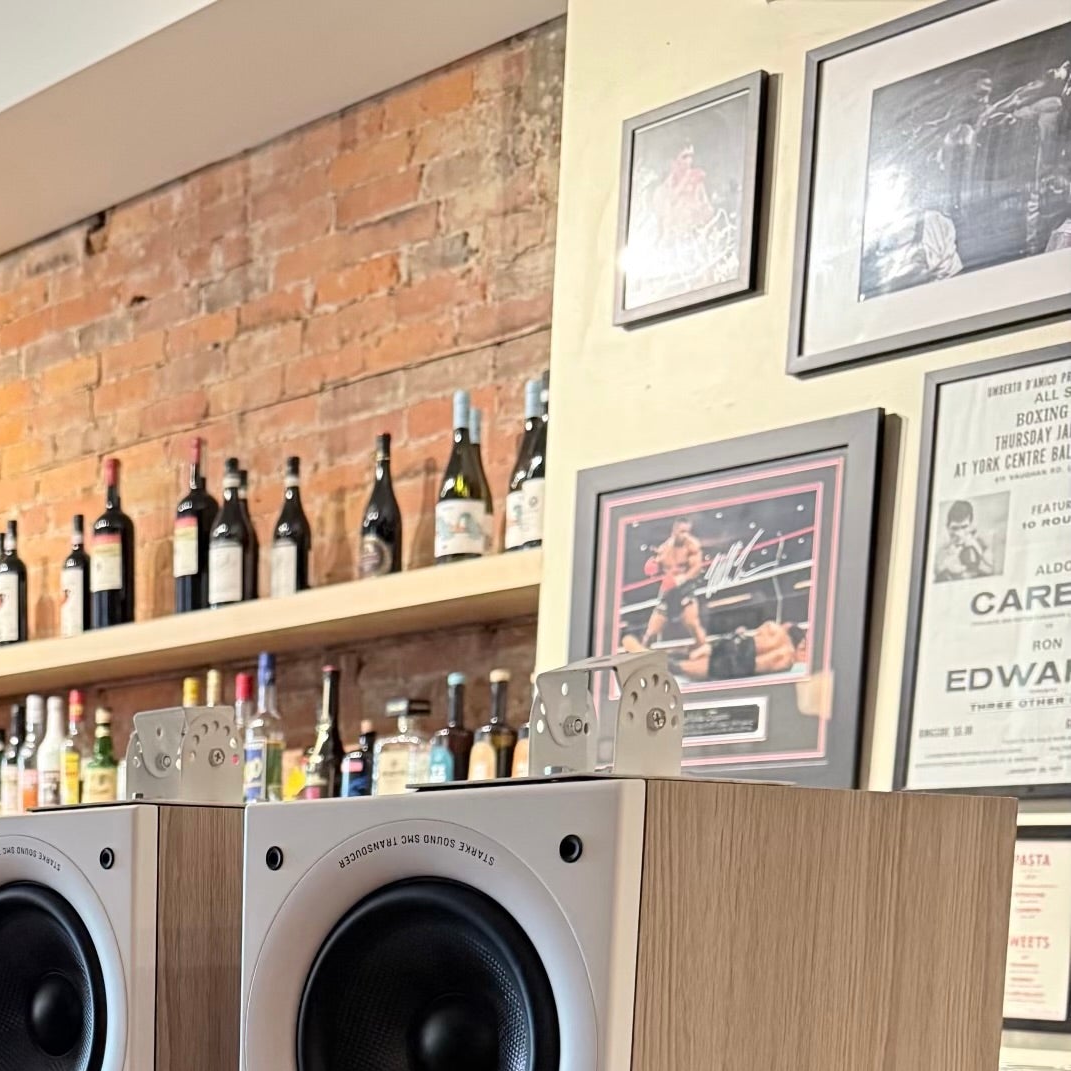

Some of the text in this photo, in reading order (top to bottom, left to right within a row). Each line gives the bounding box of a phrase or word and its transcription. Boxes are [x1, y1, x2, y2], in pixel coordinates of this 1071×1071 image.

[987, 381, 1022, 398] UMBERTO
[1034, 389, 1059, 404] ALL
[1016, 404, 1069, 427] BOXING
[995, 423, 1071, 451] THURSDAY JA
[953, 461, 967, 478] AT
[972, 455, 1000, 476] YORK
[1004, 448, 1047, 470] CENTRE
[1051, 443, 1071, 462] BAL
[970, 582, 1071, 616] CARE
[1032, 637, 1063, 652] RON
[970, 697, 1065, 712] THREE OTHER
[17, 846, 37, 857] SOUND
[338, 833, 495, 869] STARKE SOUND SMC TRANSDUCER
[38, 852, 61, 871] STARKE
